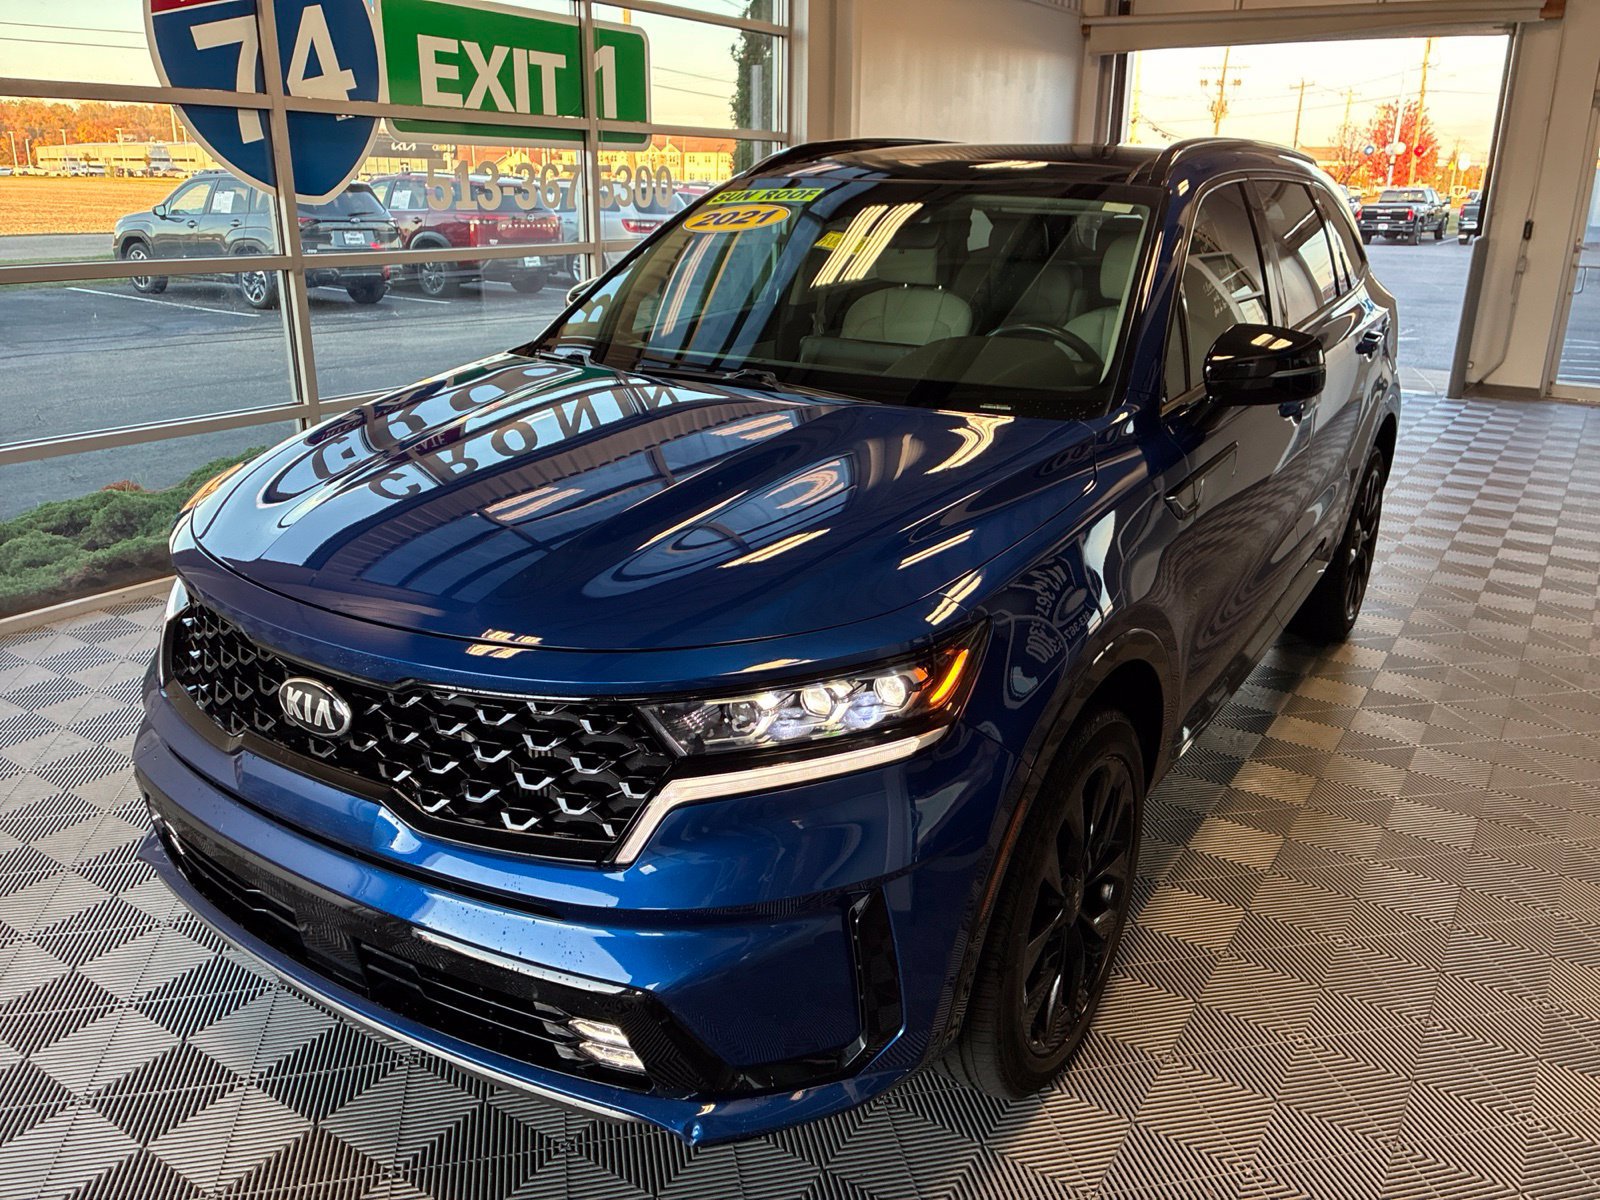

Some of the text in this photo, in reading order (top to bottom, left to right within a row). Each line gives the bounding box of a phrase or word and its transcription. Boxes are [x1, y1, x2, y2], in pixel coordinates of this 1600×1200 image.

[190, 4, 357, 144] 74
[416, 33, 618, 120] EXIT 1
[426, 160, 673, 211] 513-3675300
[712, 189, 819, 203] SUN ROOF
[691, 209, 780, 228] 2021
[286, 685, 336, 731] KIA
